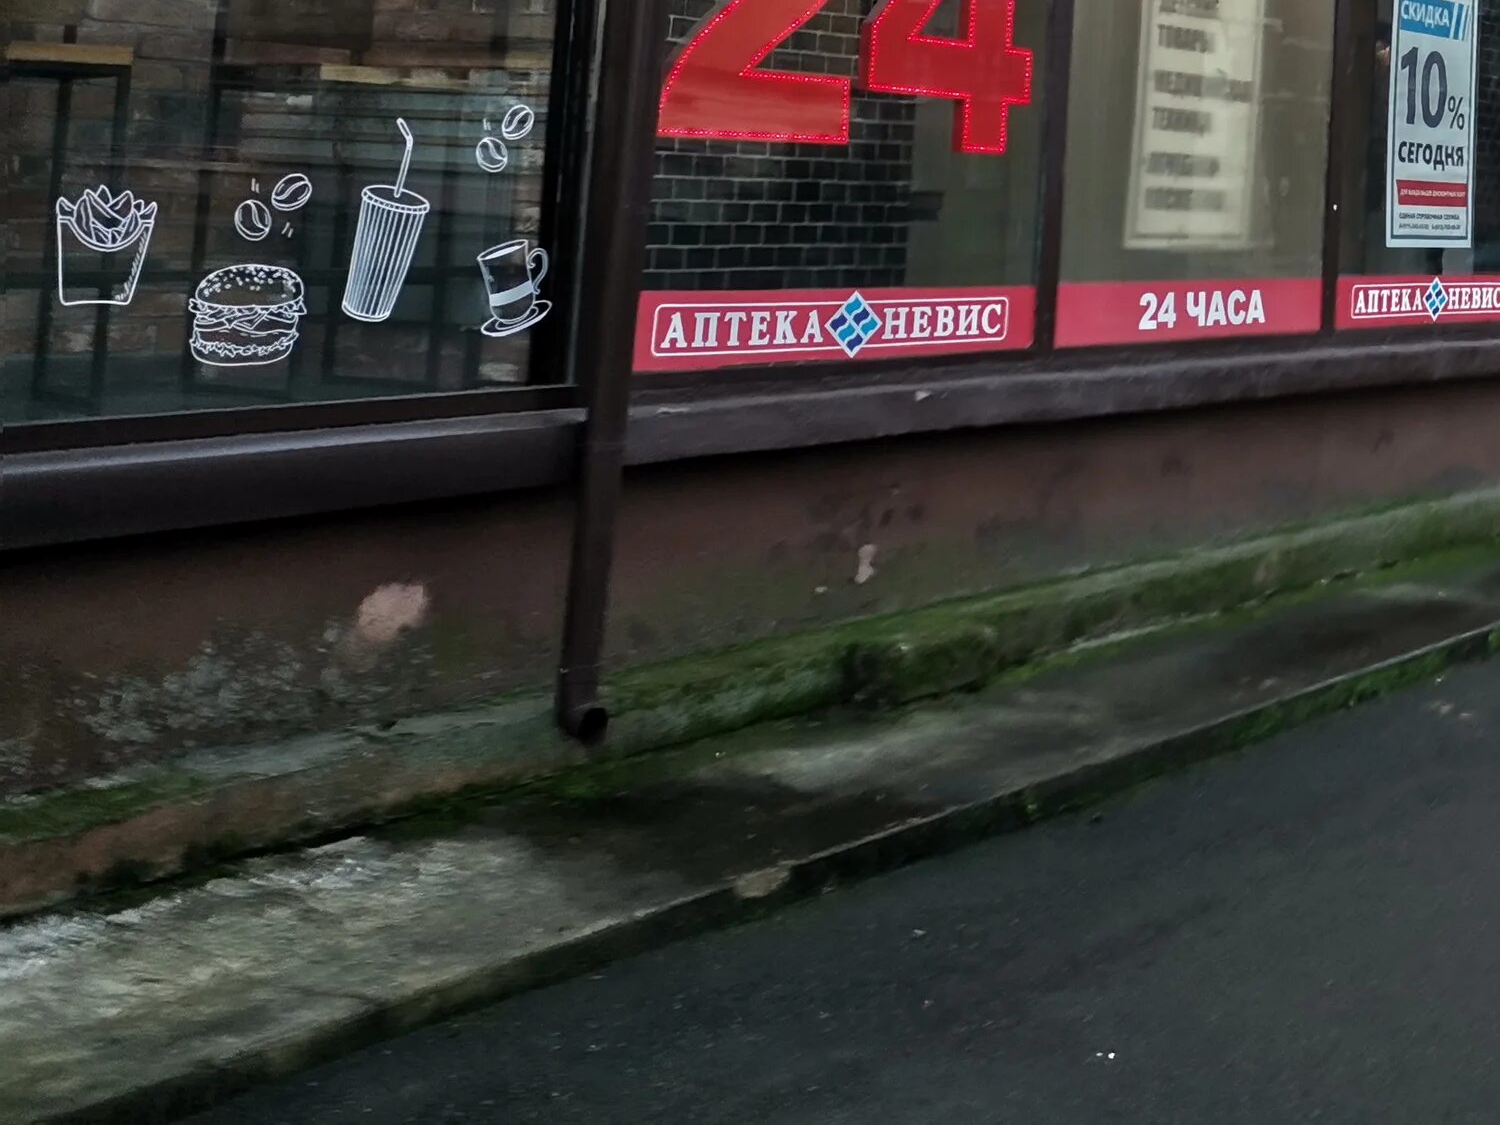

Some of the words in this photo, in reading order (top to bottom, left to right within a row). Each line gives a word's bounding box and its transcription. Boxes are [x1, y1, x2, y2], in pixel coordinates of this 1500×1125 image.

[1401, 0, 1450, 29] СКИДКА
[1398, 140, 1465, 171] СЕГОДНЯ
[1138, 291, 1176, 331] 24
[1185, 289, 1266, 327] ЧАСА
[1354, 286, 1423, 314] АПТЕКА
[660, 310, 824, 348] АПТЕКА
[882, 303, 1002, 340] НЕВИС
